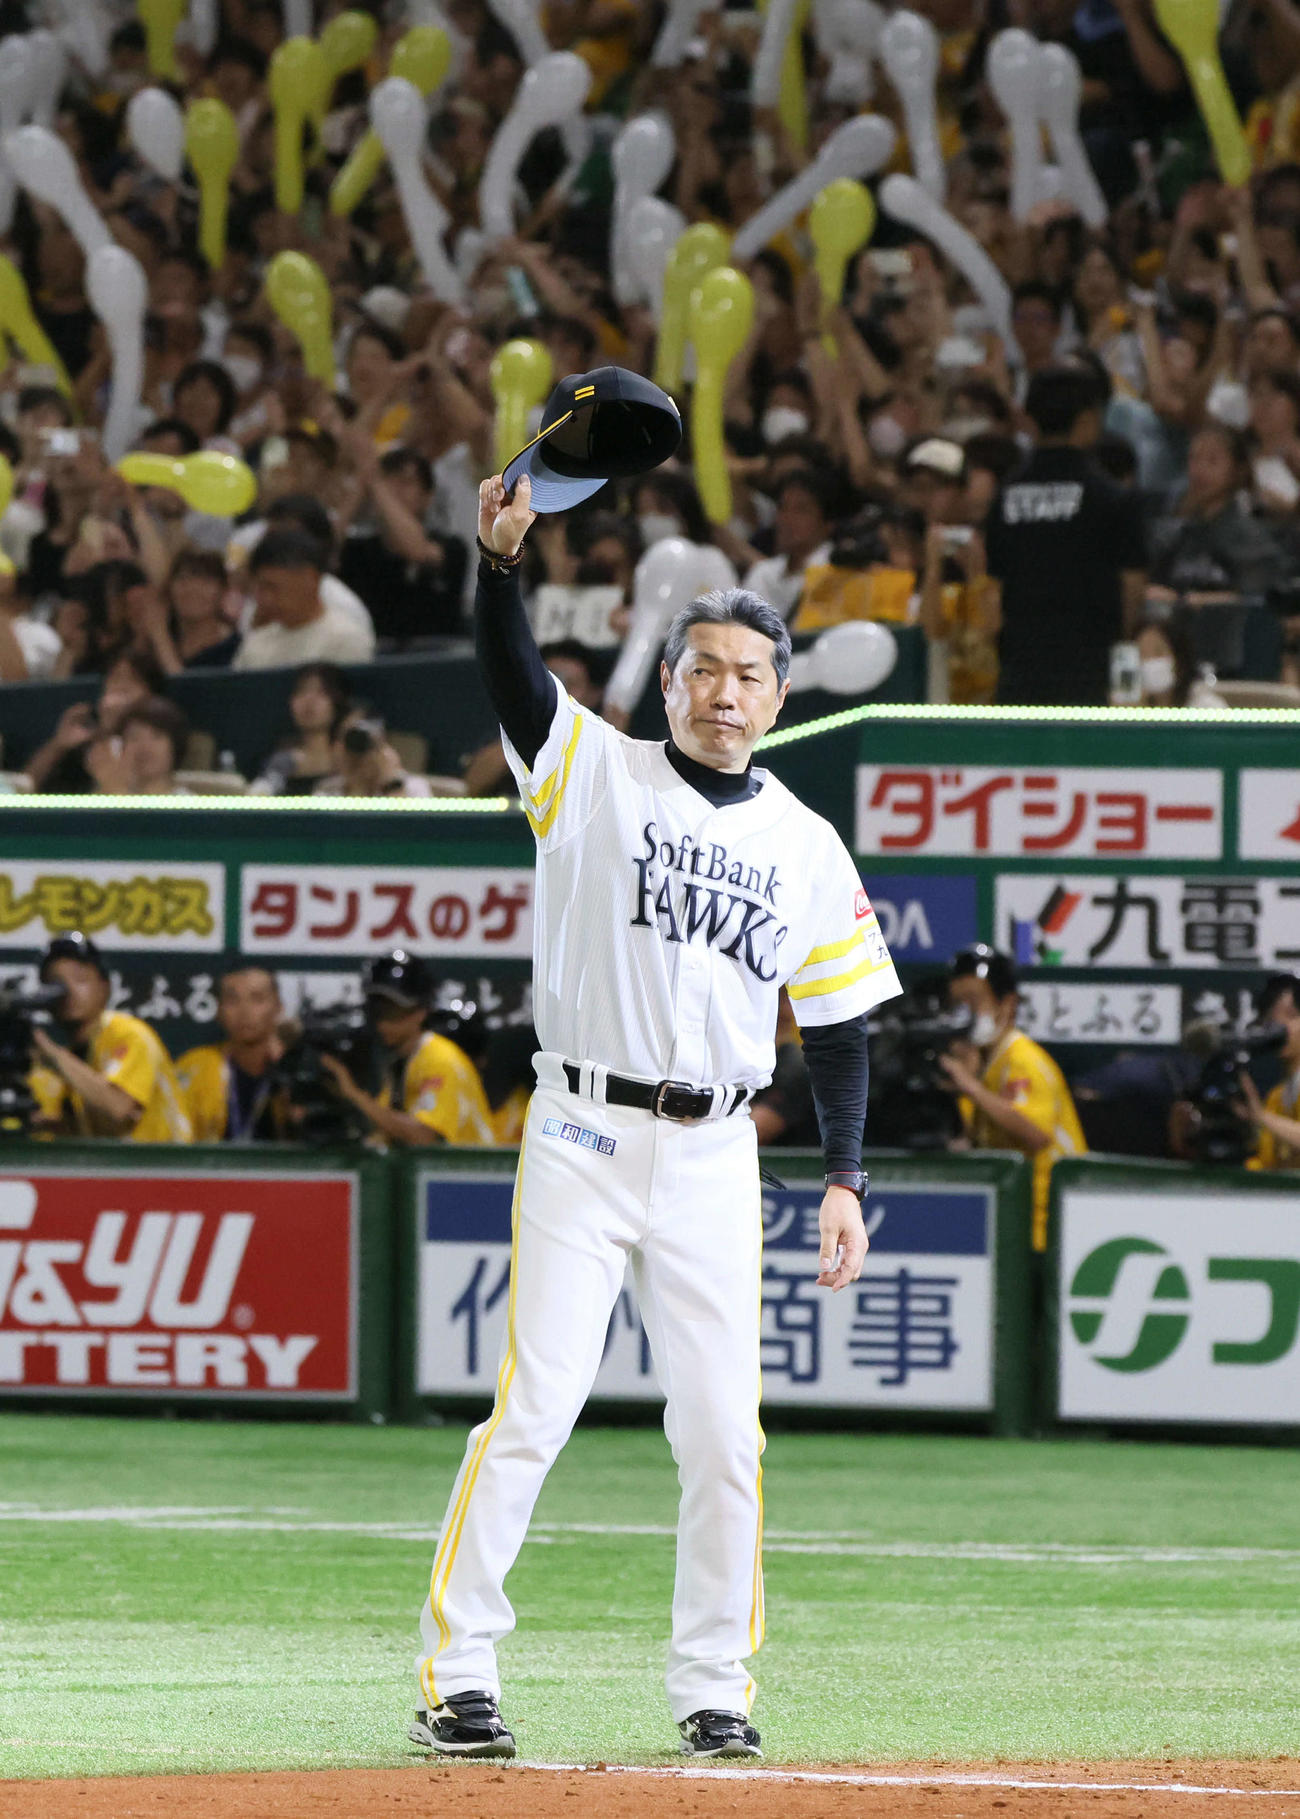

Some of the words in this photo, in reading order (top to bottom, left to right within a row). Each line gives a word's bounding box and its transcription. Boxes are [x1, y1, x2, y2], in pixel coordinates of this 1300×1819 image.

[869, 770, 1214, 852] ダイショー
[643, 822, 782, 907] SoftBank
[250, 881, 530, 942] タンスのゲ
[543, 1118, 616, 1156] 昭和建設
